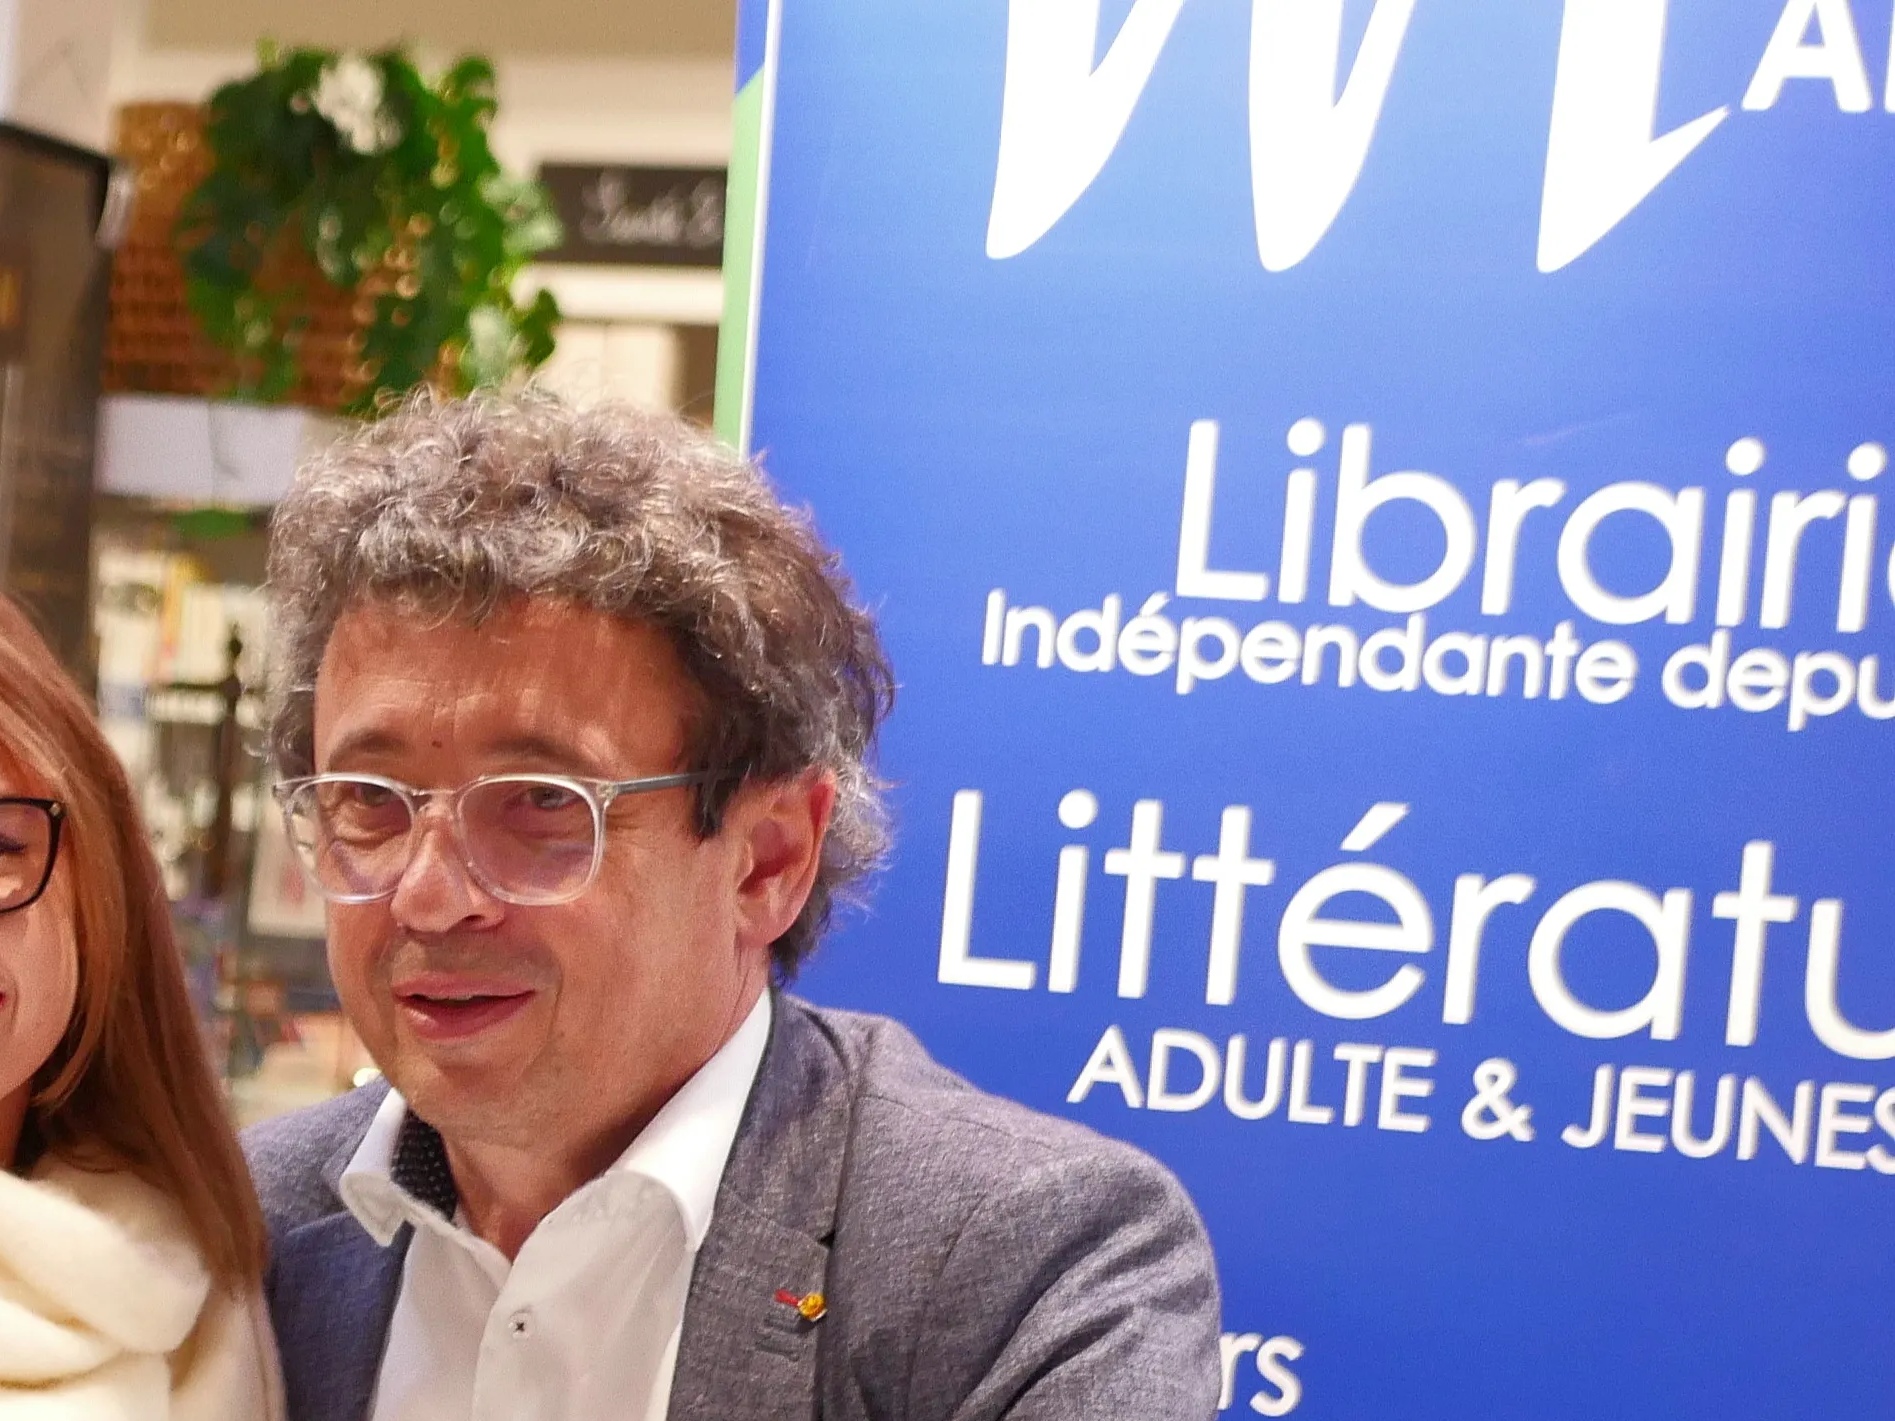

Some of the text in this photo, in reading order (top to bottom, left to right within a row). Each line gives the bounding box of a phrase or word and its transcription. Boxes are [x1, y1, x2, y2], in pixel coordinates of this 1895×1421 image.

[1175, 416, 1895, 633] Librairi
[981, 588, 1638, 705] Indépendante
[938, 789, 1895, 1060] Littératu
[1067, 1025, 1437, 1133] ADULTE
[1461, 1057, 1536, 1142] &
